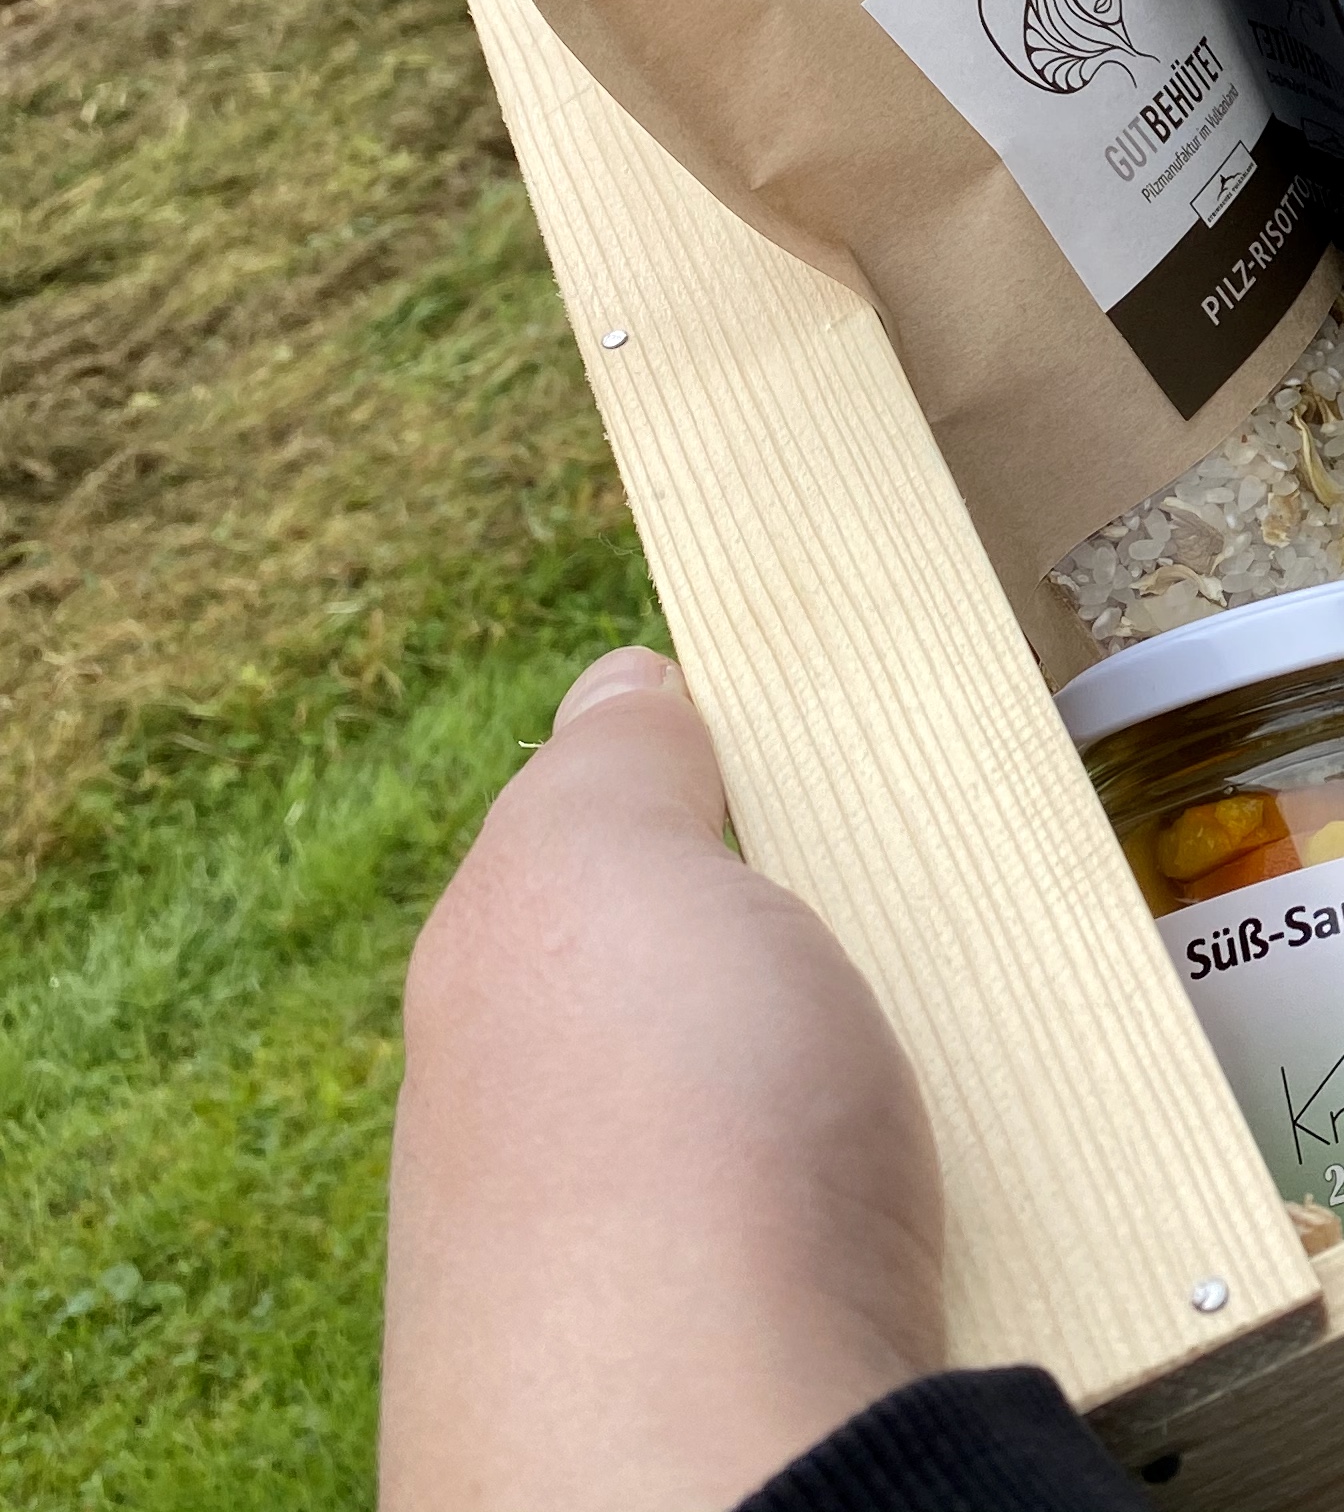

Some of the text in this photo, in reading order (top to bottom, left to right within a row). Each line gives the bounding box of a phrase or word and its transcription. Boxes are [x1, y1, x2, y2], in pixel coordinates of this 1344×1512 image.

[1104, 35, 1224, 183] GUTBEHÜTET
[1141, 82, 1240, 204] Pilzmanufaktur im Vulkanland
[1200, 174, 1311, 327] PILZ-RISOTTO
